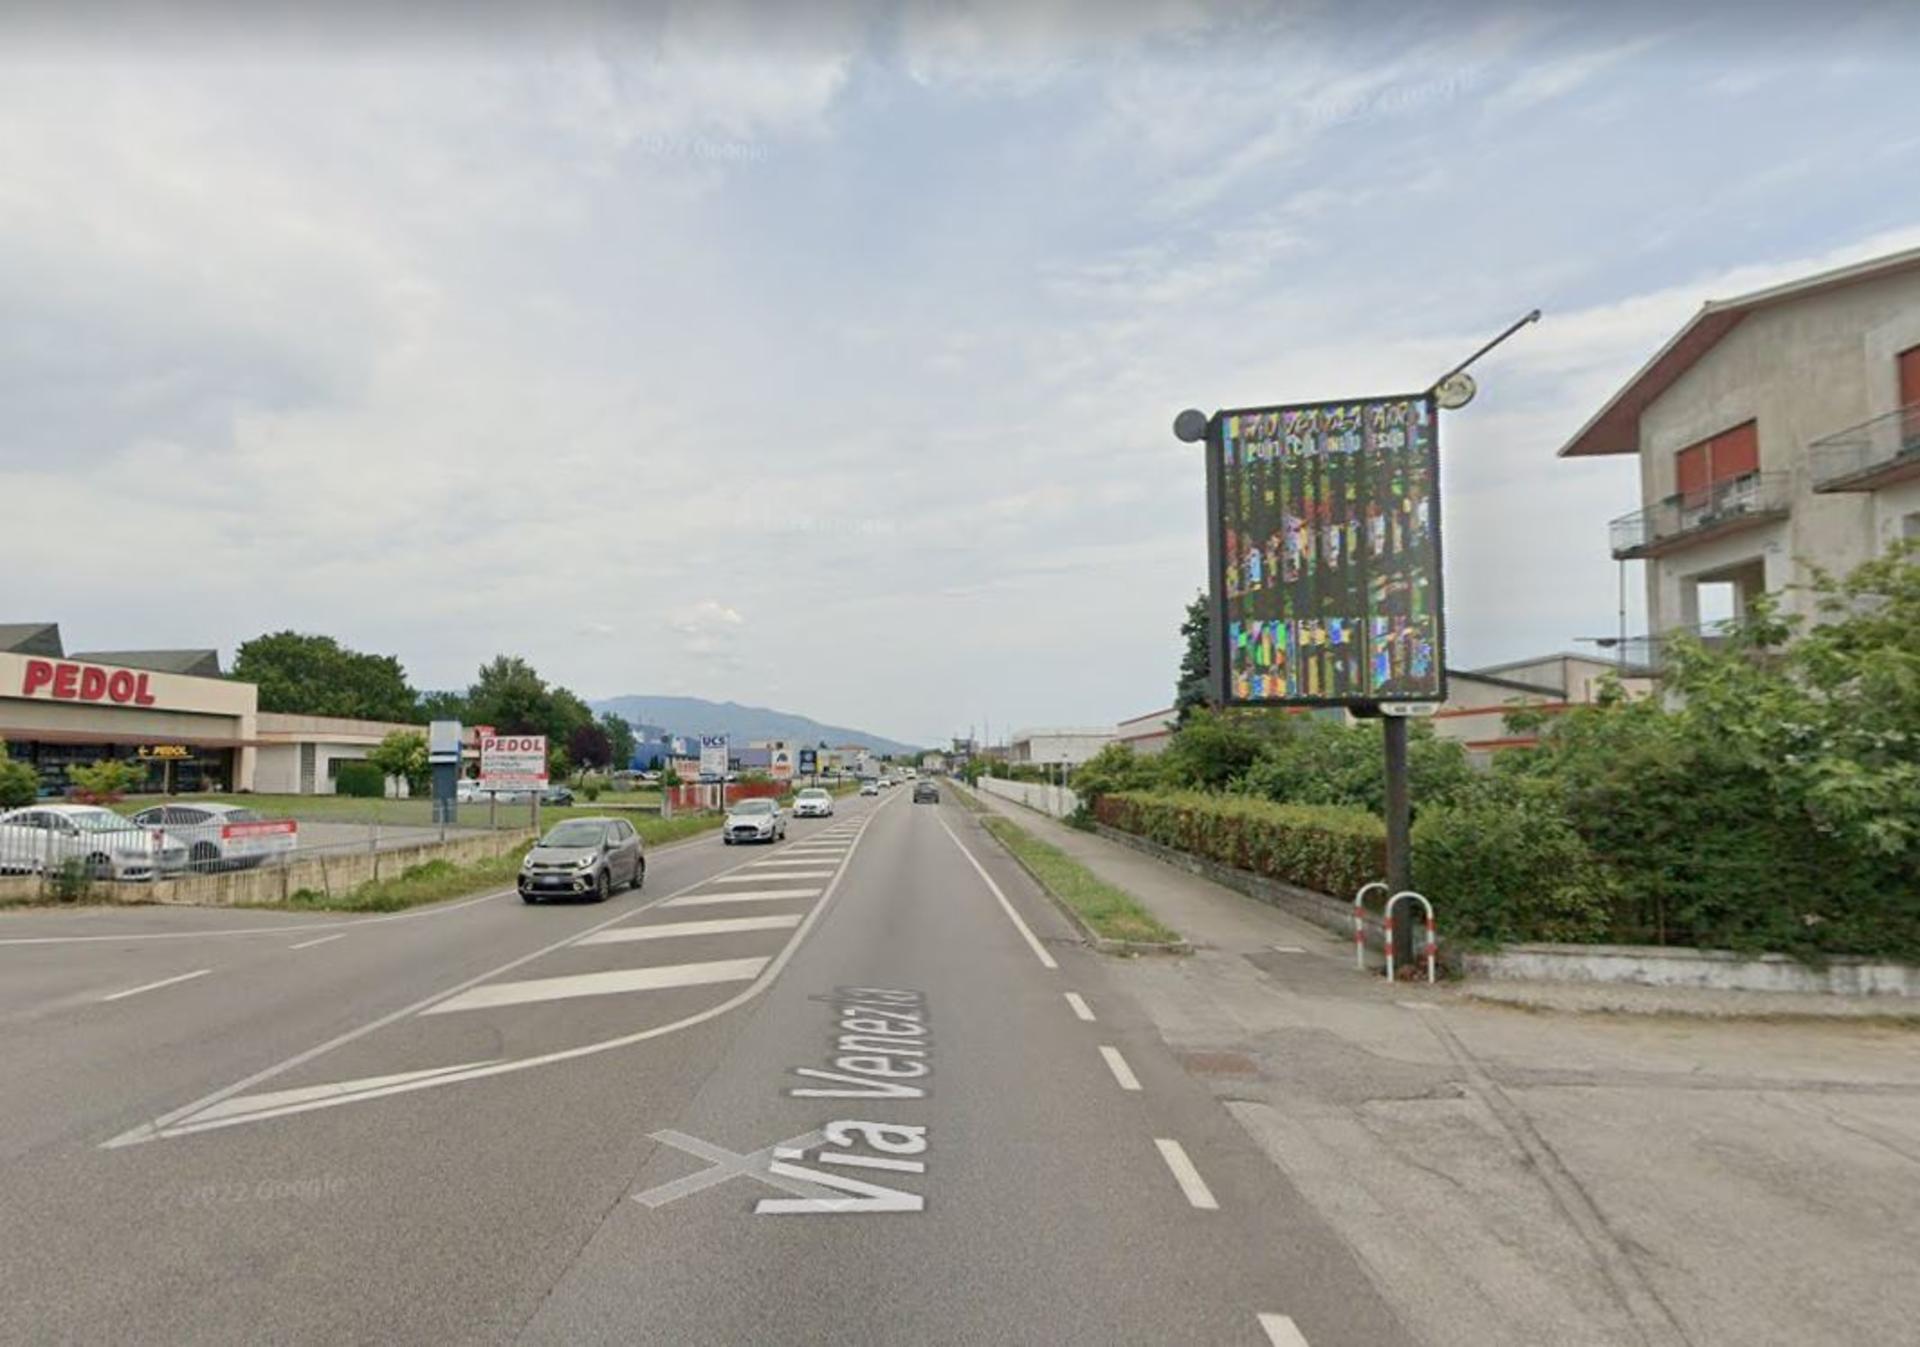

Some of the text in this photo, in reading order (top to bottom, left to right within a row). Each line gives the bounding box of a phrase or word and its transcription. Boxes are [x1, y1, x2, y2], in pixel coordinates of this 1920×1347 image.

[23, 660, 156, 705] PEDOL
[484, 739, 542, 751] PEDOL
[702, 736, 725, 746] UCS
